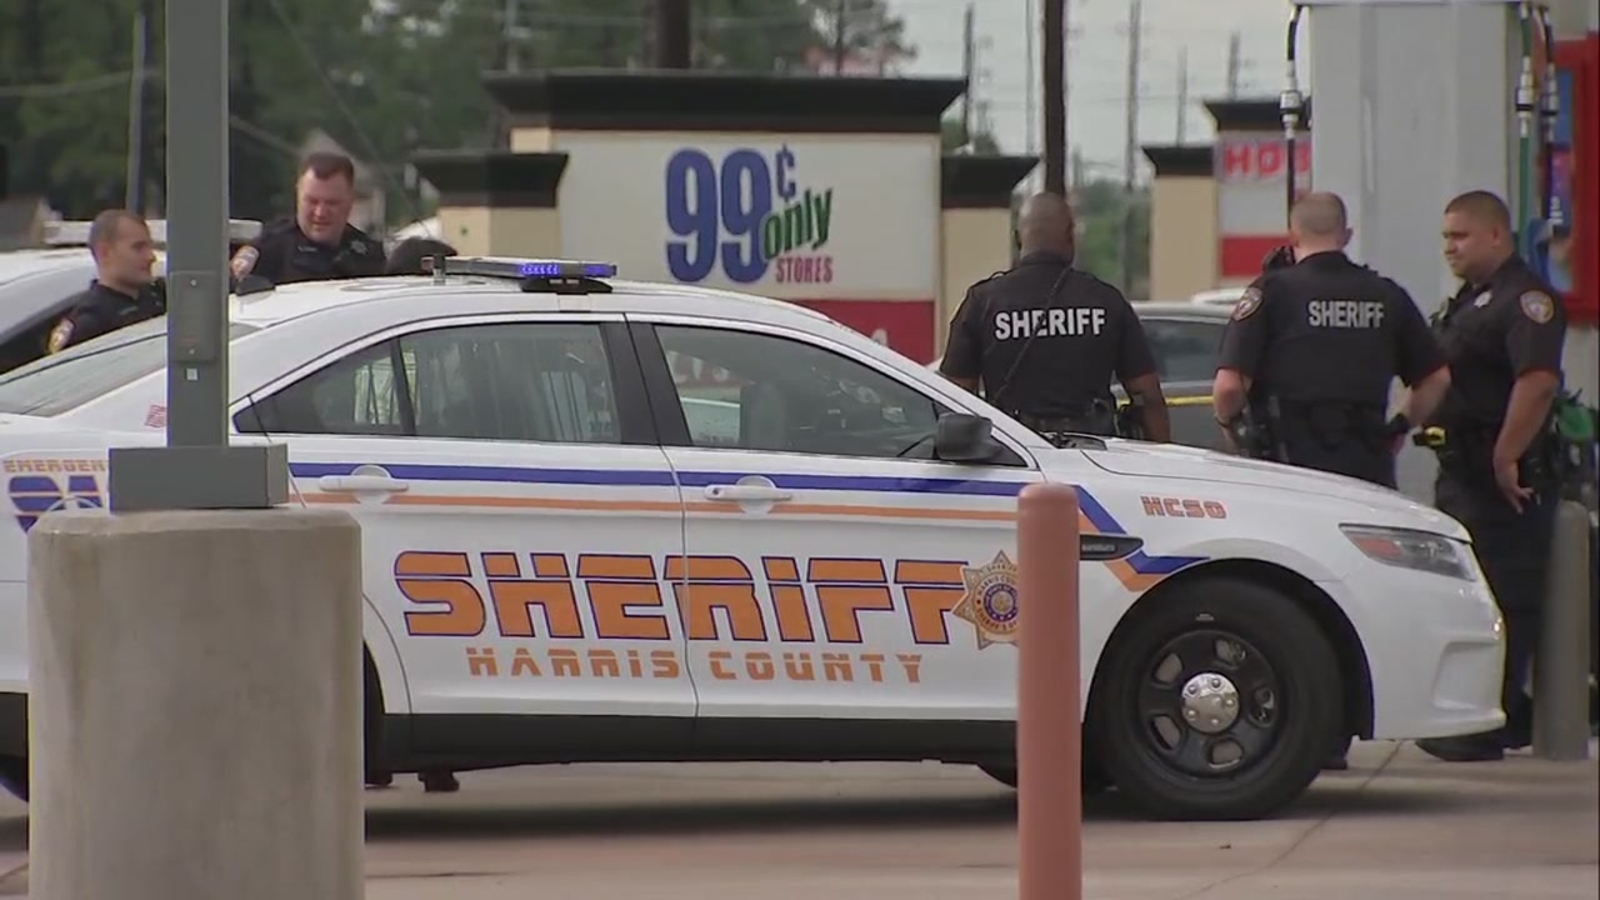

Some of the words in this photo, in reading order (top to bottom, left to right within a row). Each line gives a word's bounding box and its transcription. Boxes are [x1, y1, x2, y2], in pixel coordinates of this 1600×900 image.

[764, 187, 832, 261] only
[775, 257, 833, 283] STORES
[995, 308, 1106, 340] SHERIFF
[1308, 300, 1385, 329] SHERIFF
[2, 459, 107, 473] EMERGEN
[1140, 496, 1227, 519] HCSO
[394, 551, 969, 645] SHERIFF
[466, 647, 680, 679] HARRIS
[708, 651, 922, 683] COUNTY
